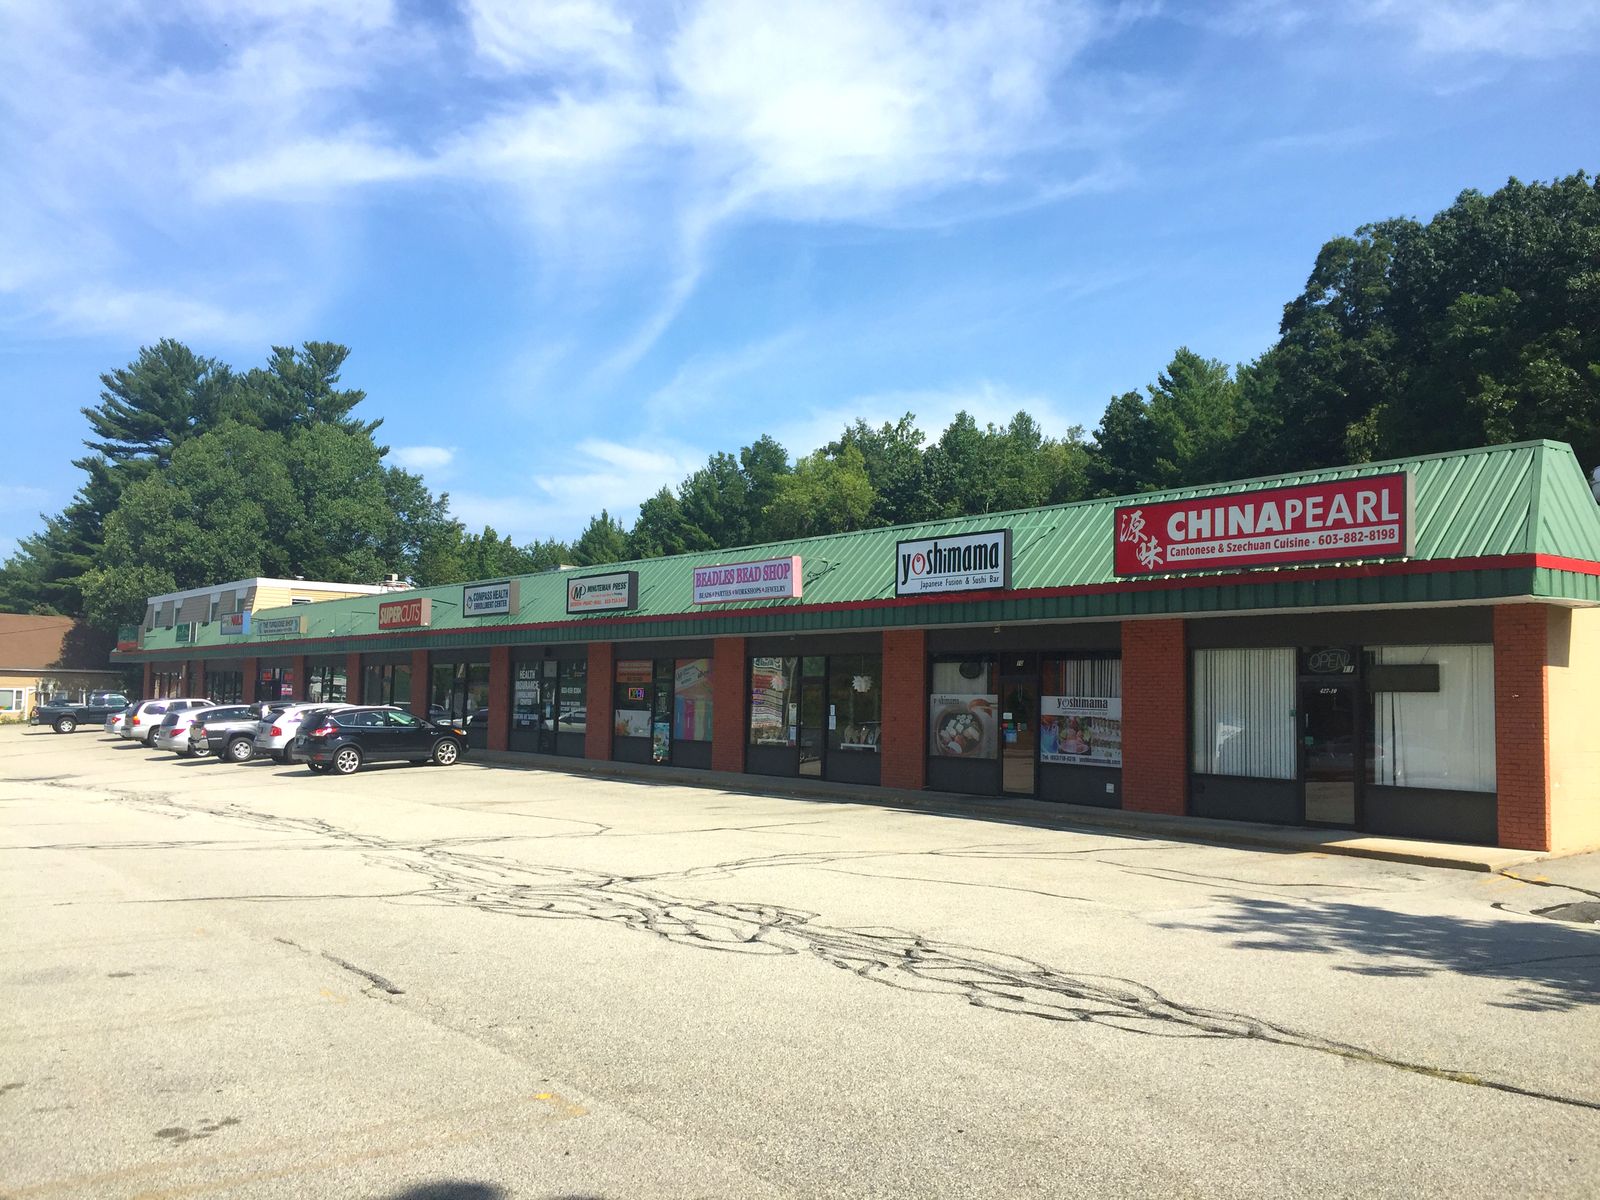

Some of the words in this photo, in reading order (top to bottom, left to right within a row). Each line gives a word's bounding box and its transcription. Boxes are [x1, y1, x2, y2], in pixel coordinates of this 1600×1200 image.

[1170, 543, 1216, 557] Cantonese
[1217, 543, 1225, 553] &
[1226, 539, 1271, 552] Szechuan
[1273, 536, 1310, 549] Cuisine
[1318, 528, 1395, 546] 603-882-8198
[901, 541, 999, 585] yoshimama
[695, 568, 735, 588] BEADLES
[736, 566, 761, 583] BEAD
[763, 562, 791, 581] SHOP
[920, 579, 943, 590] Japanese
[945, 578, 963, 587] Fusion
[965, 577, 970, 585] &
[972, 575, 987, 584] Sushi
[989, 575, 1000, 583] Bar
[612, 581, 627, 590] PRESS
[380, 603, 421, 625] SUPERCUTS
[1310, 653, 1345, 669] OPEN
[519, 669, 535, 679] HEALTH
[1057, 697, 1108, 709] yoshimama
